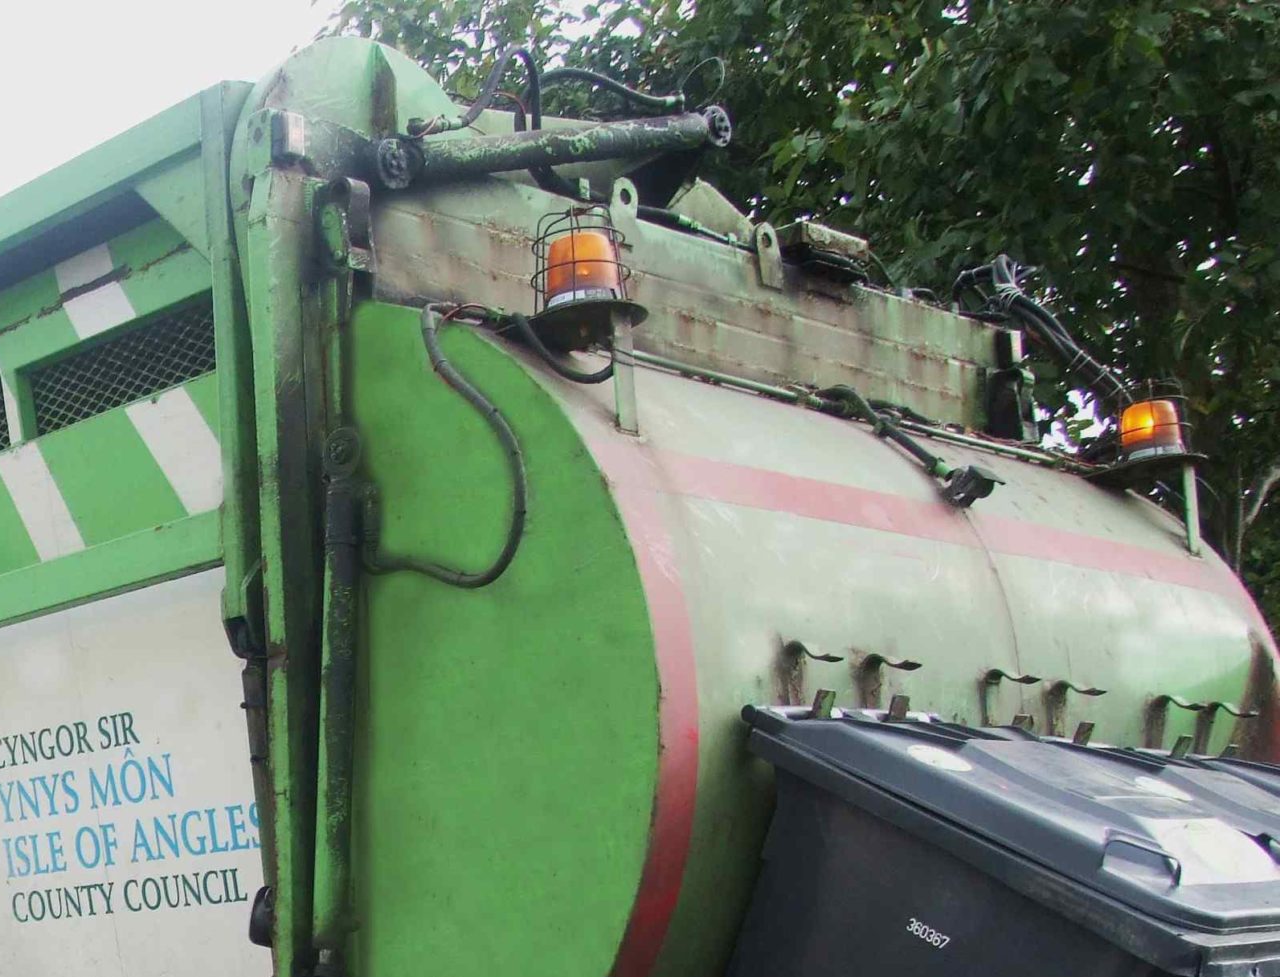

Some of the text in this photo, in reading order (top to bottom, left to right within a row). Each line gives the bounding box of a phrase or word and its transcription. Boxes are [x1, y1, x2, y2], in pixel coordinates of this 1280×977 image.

[97, 711, 140, 750] SIR
[89, 747, 175, 809] MÔN
[2, 831, 67, 878] ISLE
[75, 823, 118, 869] OF
[12, 868, 248, 923] COUNTY COUNCIL
[906, 918, 950, 949] 360367
